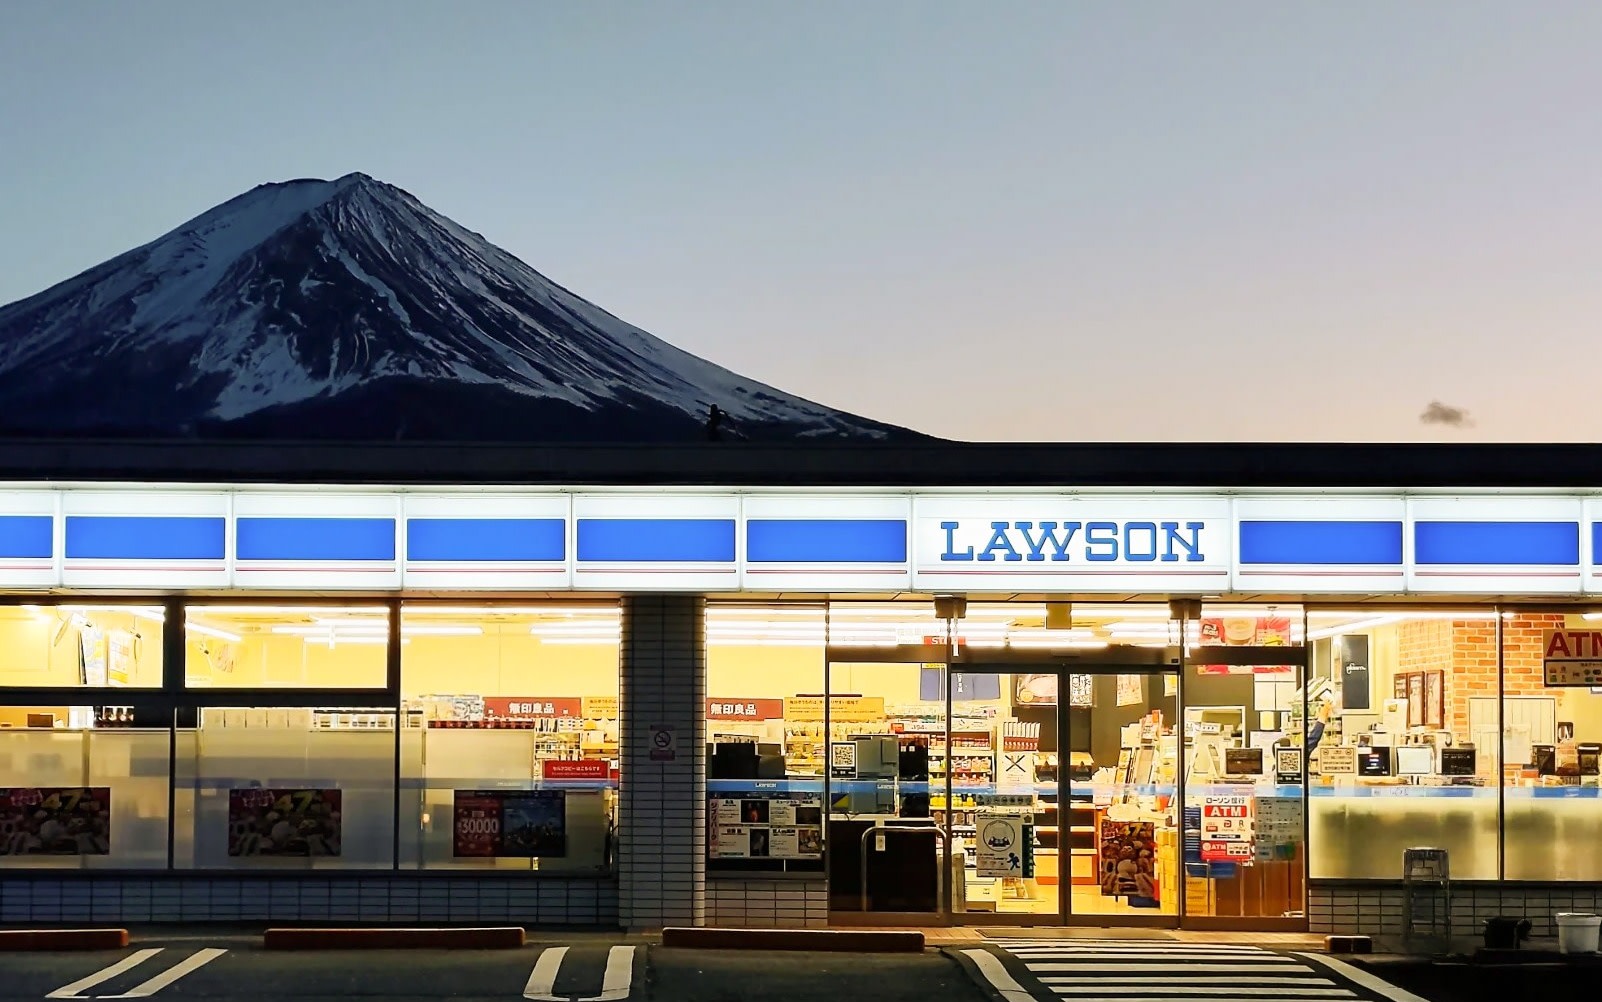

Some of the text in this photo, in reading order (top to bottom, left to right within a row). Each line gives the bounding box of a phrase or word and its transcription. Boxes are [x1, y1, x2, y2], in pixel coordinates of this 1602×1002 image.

[940, 522, 1205, 561] LAWSON
[509, 702, 555, 714] 無印良品
[710, 703, 757, 716] 無印良品
[1210, 806, 1242, 817] ATM
